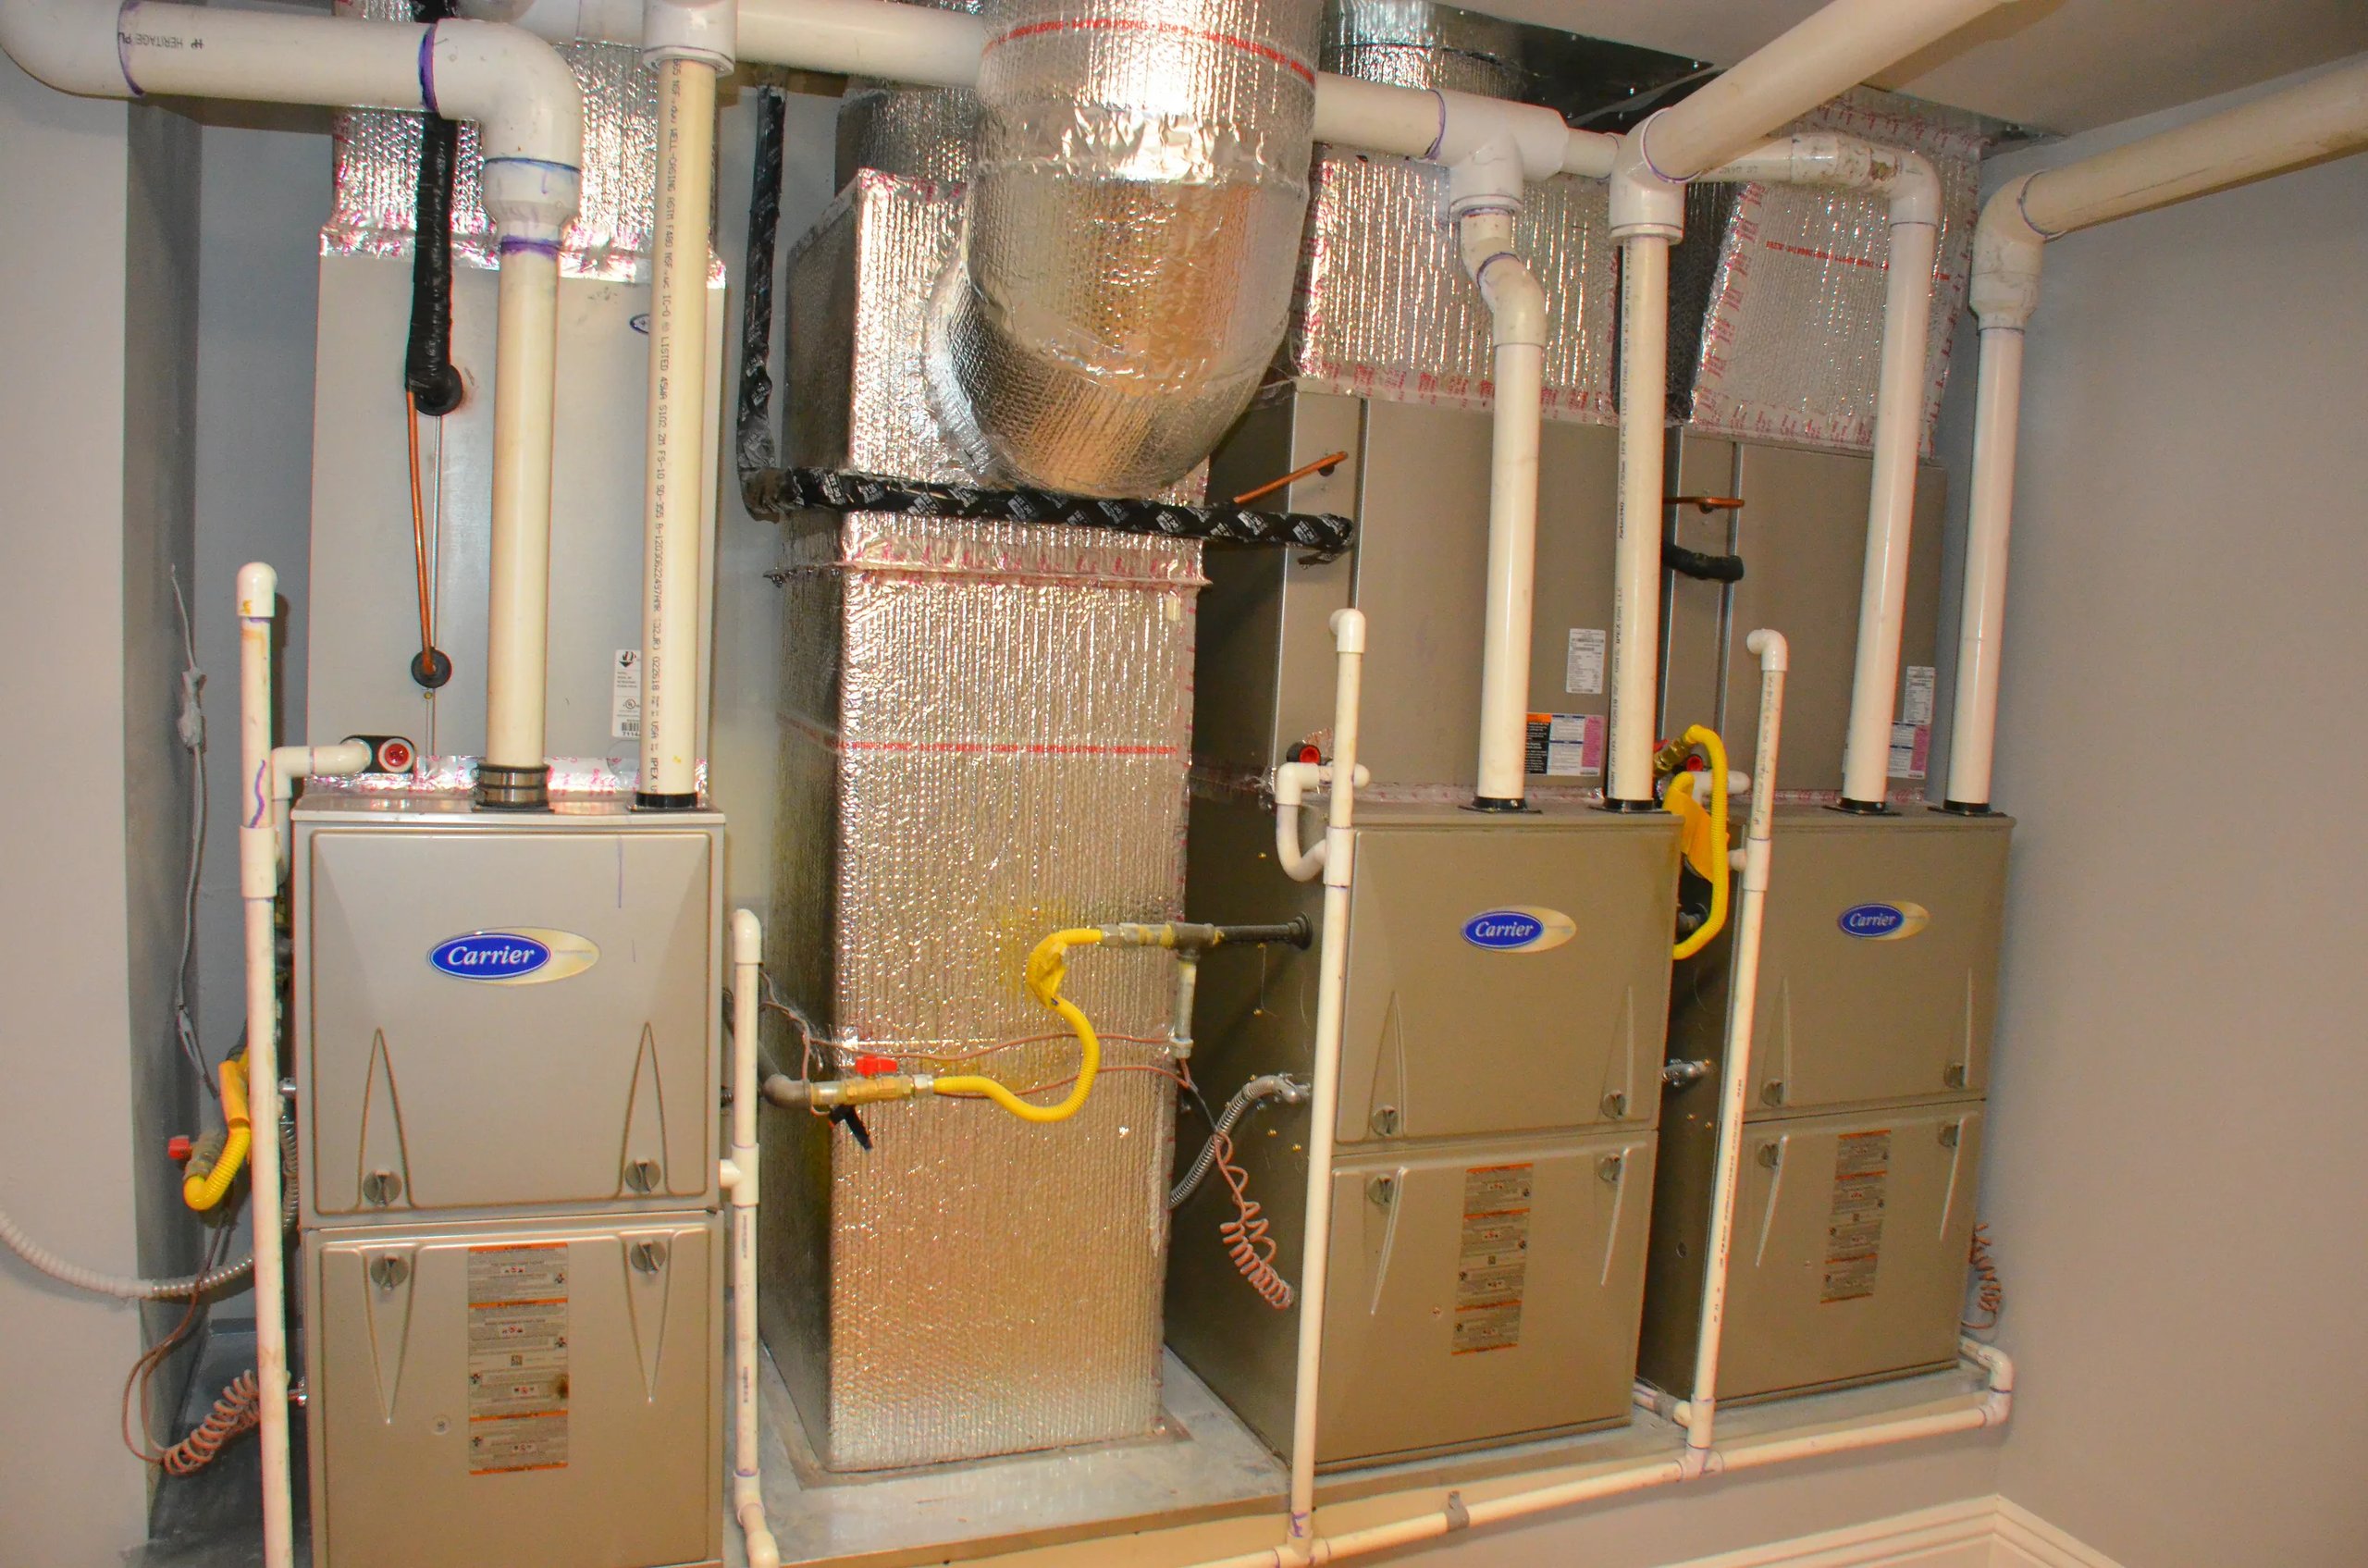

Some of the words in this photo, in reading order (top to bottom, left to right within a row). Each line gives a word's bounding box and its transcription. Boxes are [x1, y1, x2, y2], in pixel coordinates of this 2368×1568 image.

[135, 33, 184, 49] HERITAGE
[667, 129, 679, 192] WELL-CASING
[666, 196, 676, 221] ASTM
[660, 336, 670, 371] LISTED
[649, 757, 659, 781] IPEX
[1474, 920, 1535, 937] Carrier
[1849, 912, 1896, 927] Carrier
[447, 945, 536, 966] Carrier
